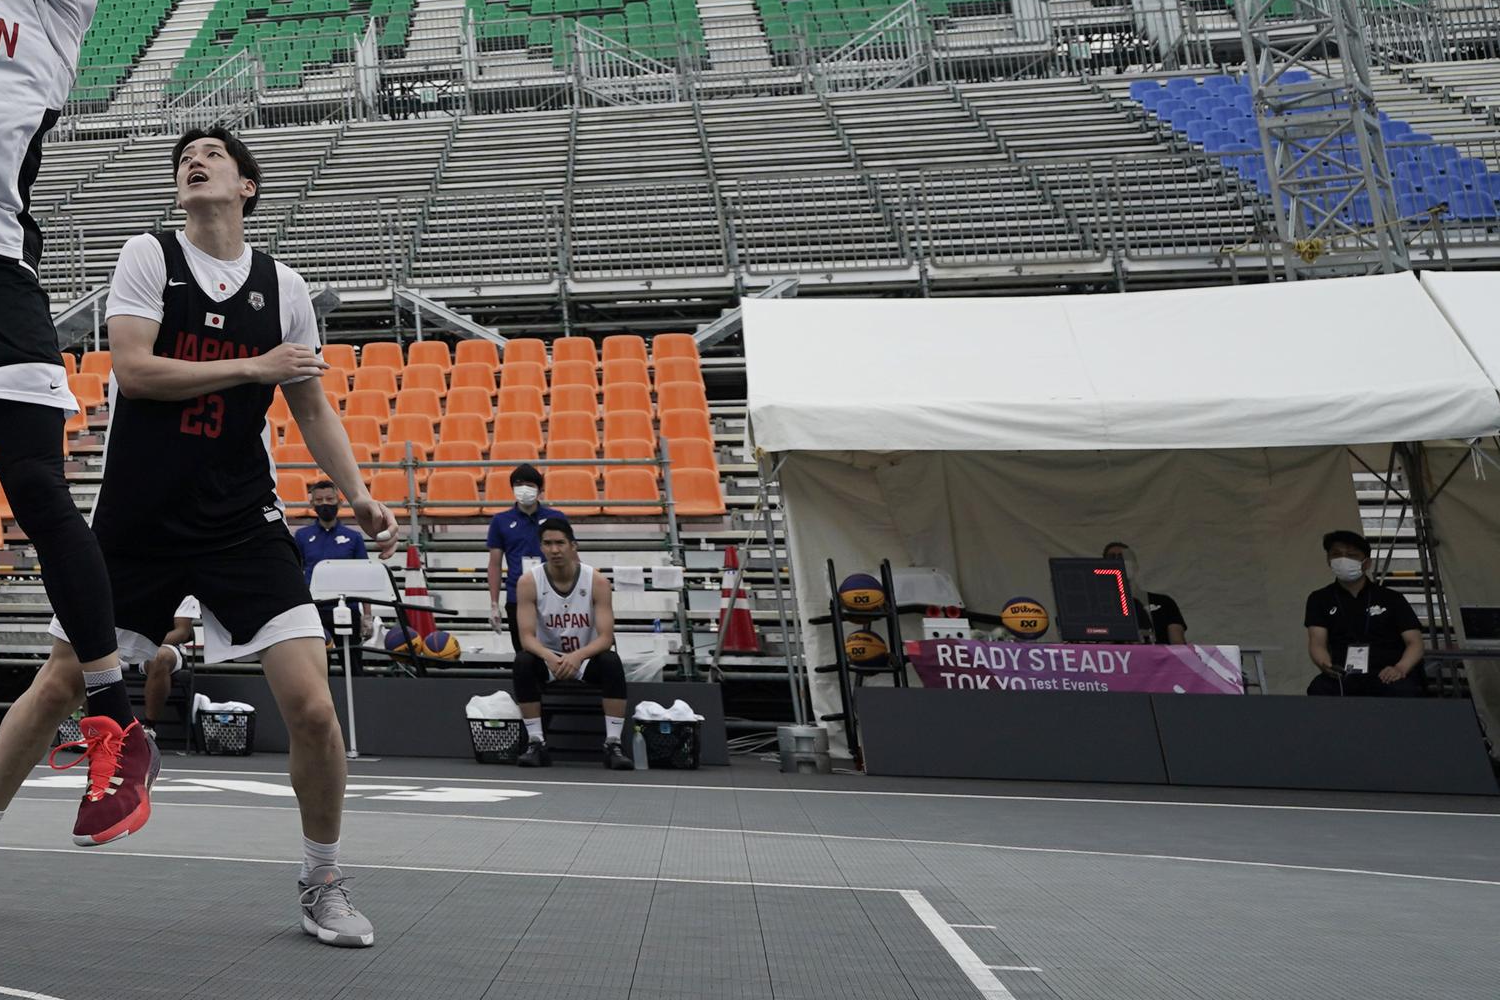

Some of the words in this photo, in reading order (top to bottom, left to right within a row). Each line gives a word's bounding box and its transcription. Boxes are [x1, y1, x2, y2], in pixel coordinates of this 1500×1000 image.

[180, 393, 225, 439] 23
[545, 613, 590, 629] JAPAN
[560, 635, 581, 653] 20
[936, 644, 1022, 671] READY
[1028, 649, 1132, 674] STEADY
[1029, 677, 1058, 690] Test
[1062, 678, 1109, 692] Events
